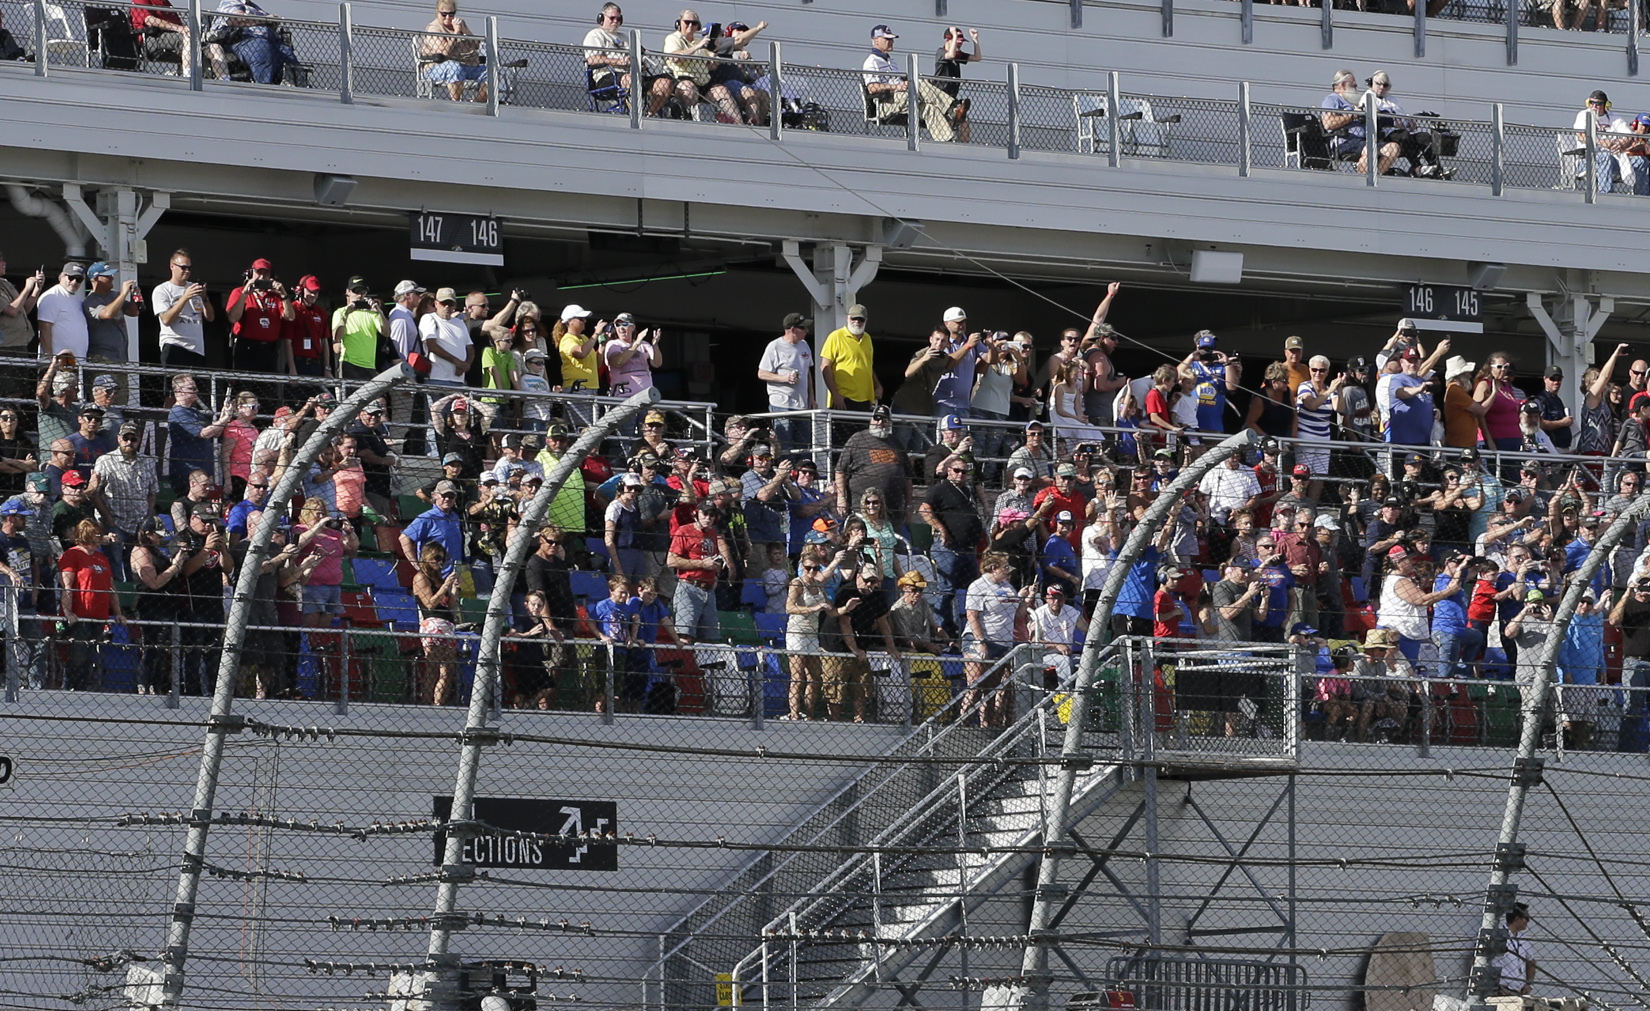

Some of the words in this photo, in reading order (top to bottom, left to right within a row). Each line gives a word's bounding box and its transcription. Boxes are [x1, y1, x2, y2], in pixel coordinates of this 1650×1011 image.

[418, 215, 443, 243] 147
[470, 219, 498, 247] 146
[1409, 286, 1434, 313] 146
[1455, 290, 1478, 316] 145
[458, 835, 543, 865] ECTIONS
